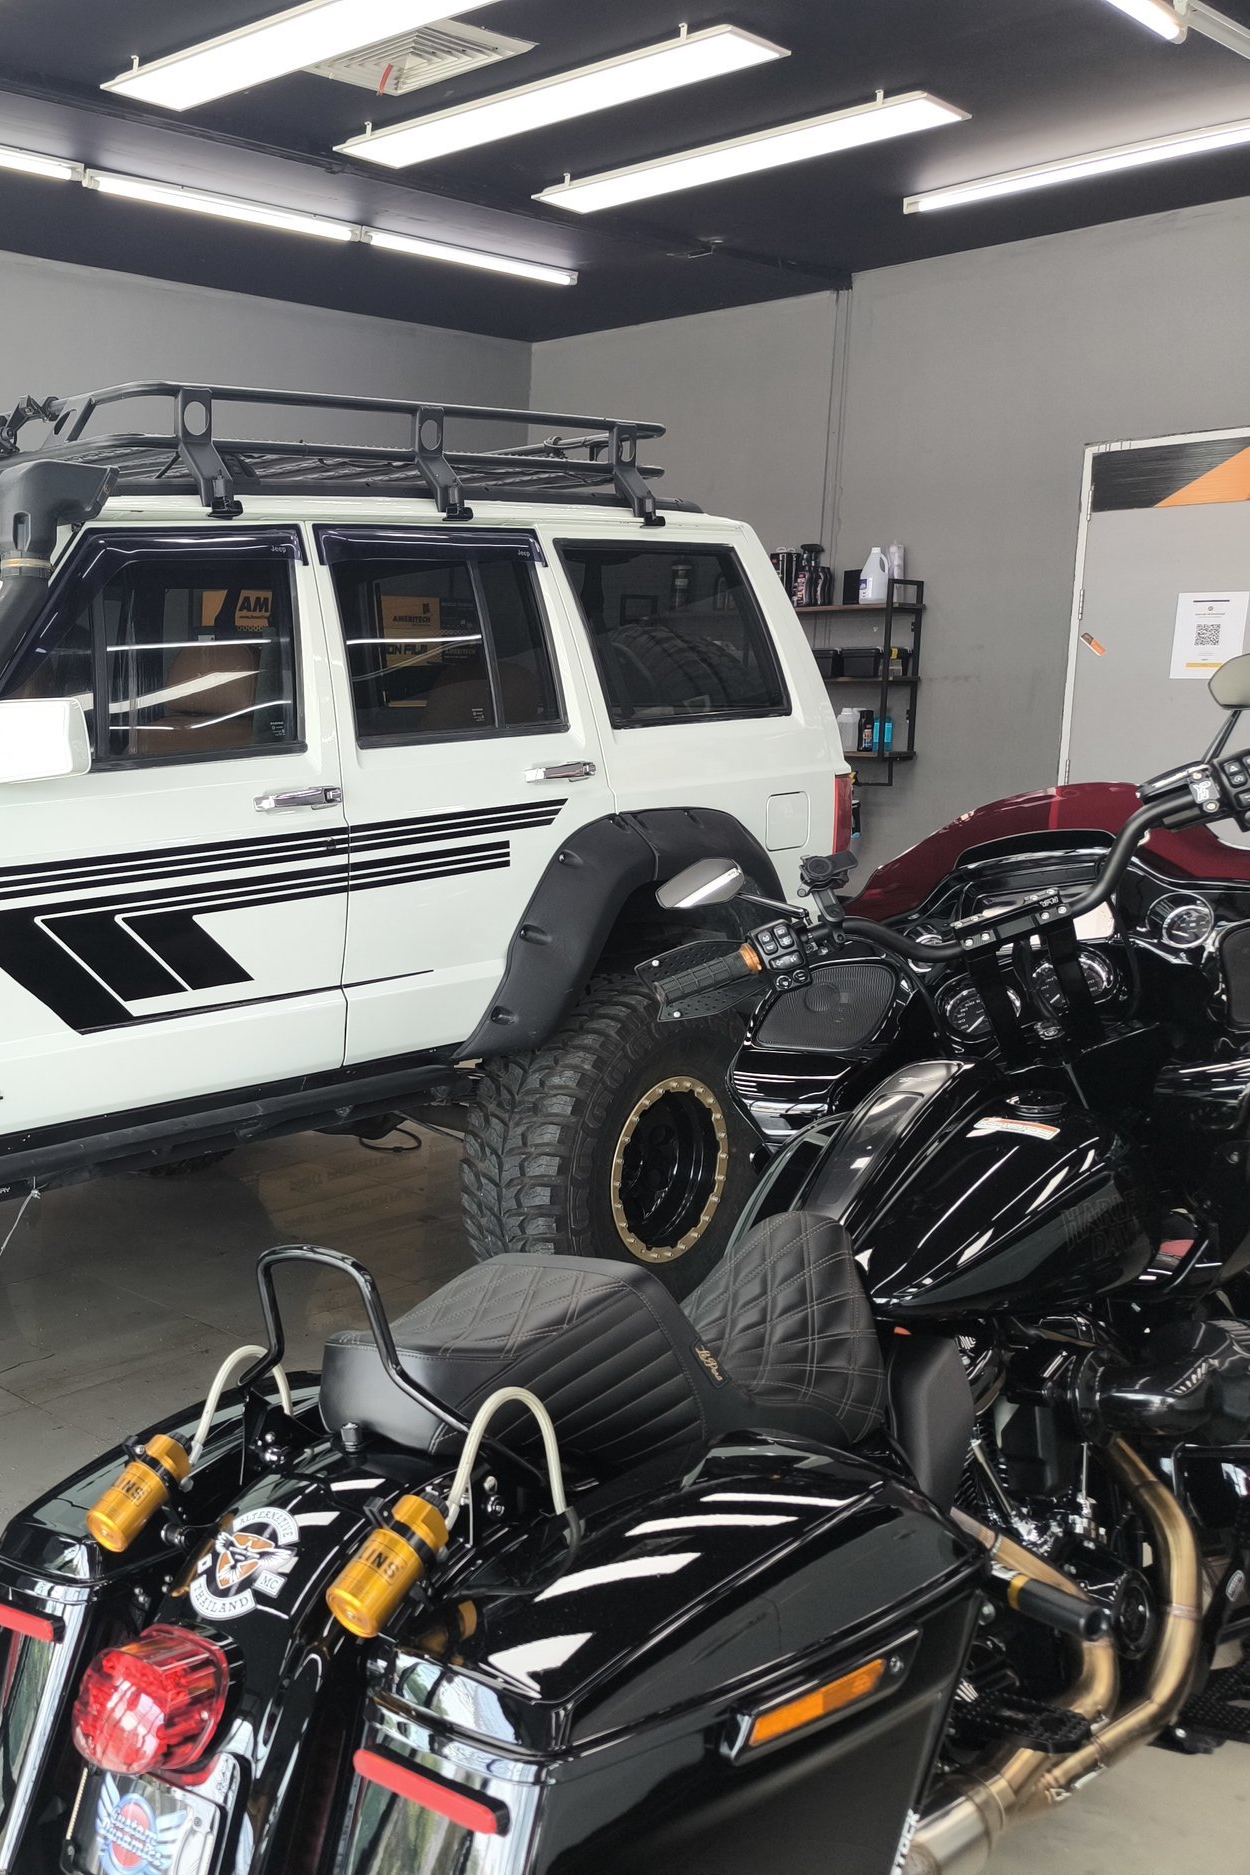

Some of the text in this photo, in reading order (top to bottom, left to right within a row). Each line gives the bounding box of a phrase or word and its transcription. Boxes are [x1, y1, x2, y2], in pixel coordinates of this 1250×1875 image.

[270, 545, 287, 554] Jeep
[517, 549, 531, 557] Jeep
[392, 615, 431, 624] AMERITECH
[238, 1510, 294, 1539] ALTERNATIVE
[260, 1575, 279, 1590] MC
[193, 1584, 250, 1614] THAILAND
